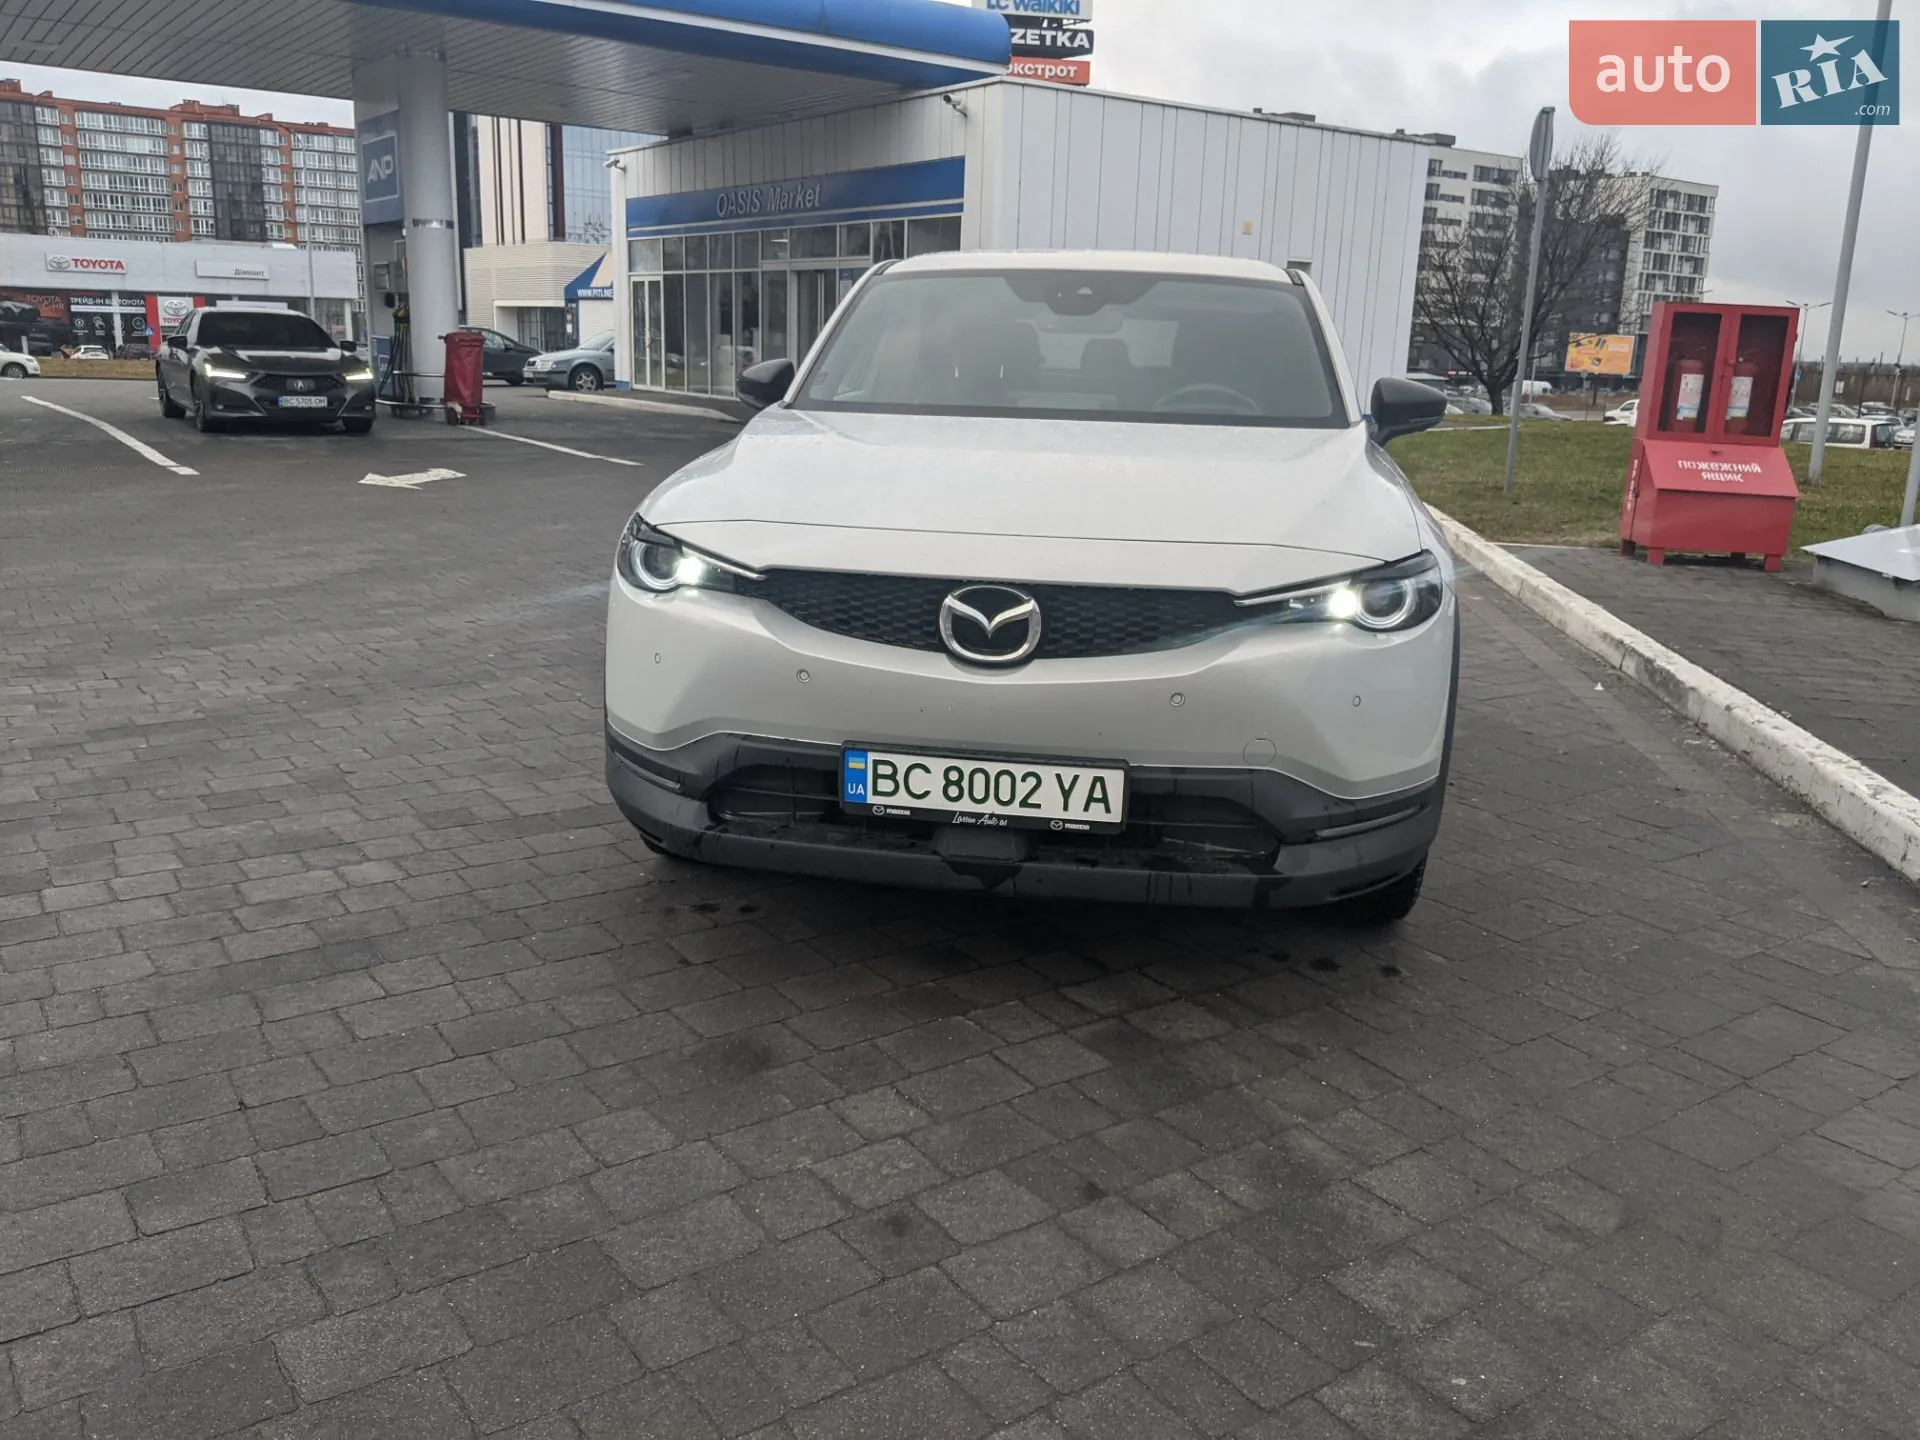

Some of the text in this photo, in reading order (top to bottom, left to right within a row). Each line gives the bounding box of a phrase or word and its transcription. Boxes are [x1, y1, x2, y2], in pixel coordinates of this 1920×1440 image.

[1011, 28, 1090, 48] ZETKA
[766, 182, 822, 212] Market
[72, 258, 125, 270] TOYOTA
[26, 294, 61, 303] TOYOTA
[848, 758, 1112, 814] UA BC 8002 YA
